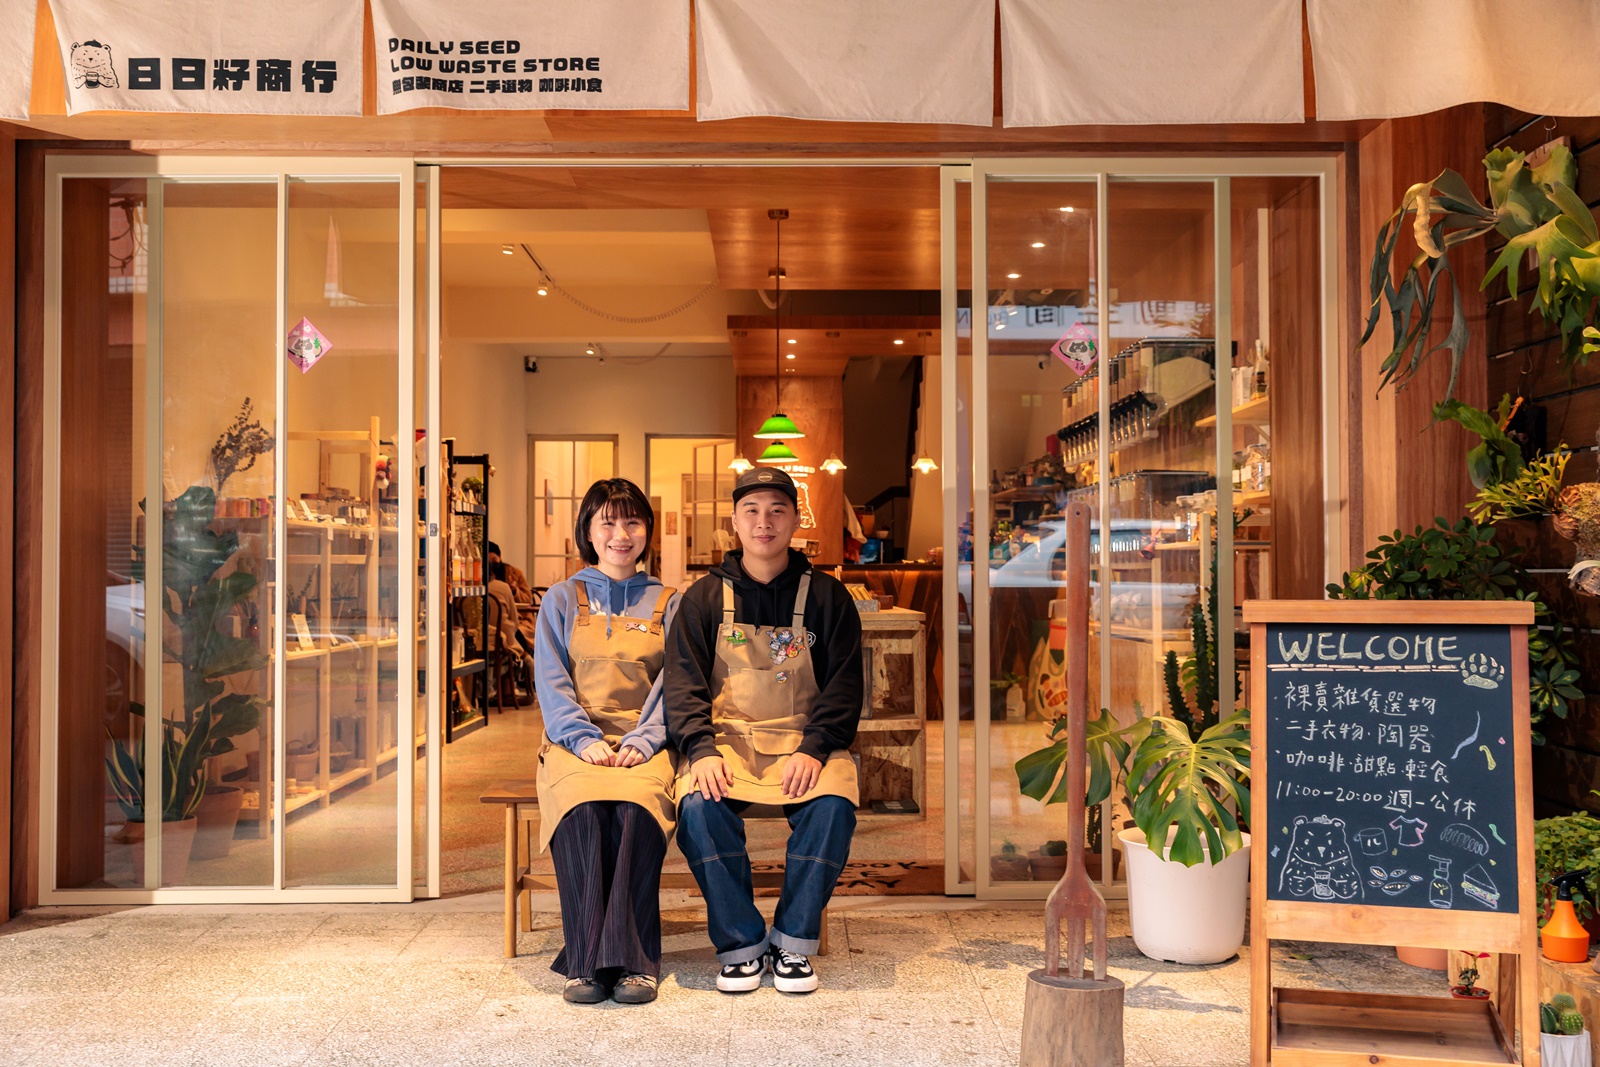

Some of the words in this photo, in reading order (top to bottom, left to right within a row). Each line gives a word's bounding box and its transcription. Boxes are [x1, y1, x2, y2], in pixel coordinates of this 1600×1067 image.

[389, 38, 454, 54] DAILY
[459, 40, 521, 55] SEED
[390, 56, 433, 73] LOW
[438, 59, 517, 74] WASTE
[523, 57, 600, 73] STORE
[128, 58, 337, 93] 日日籽商行
[469, 79, 533, 94] 二手選物
[539, 77, 603, 93] 咖啡小食
[1278, 632, 1463, 663] WELCOME
